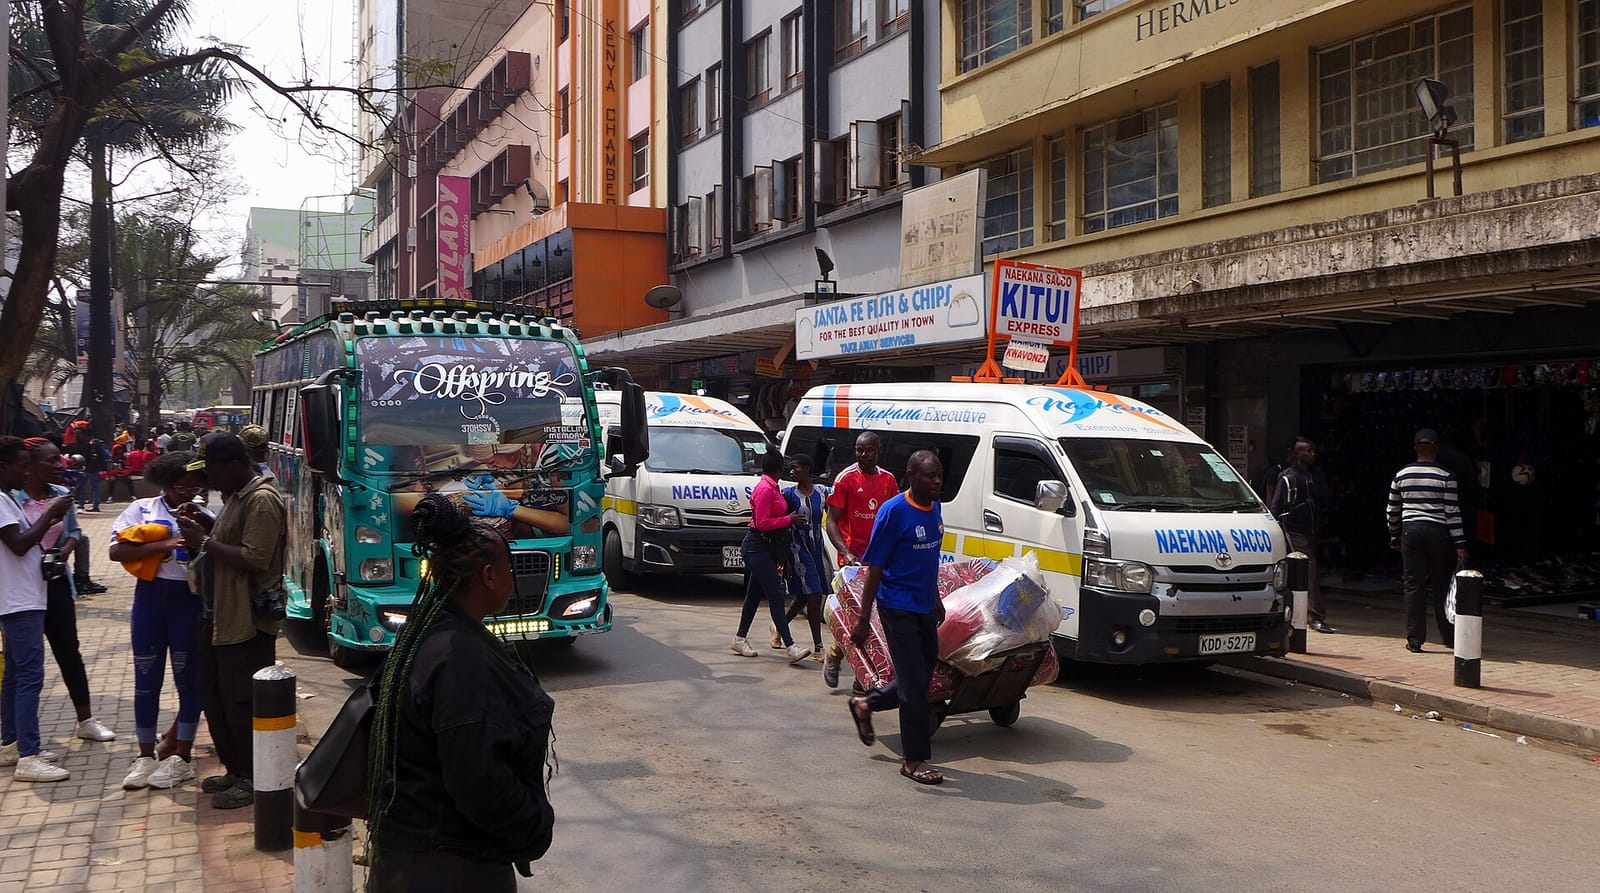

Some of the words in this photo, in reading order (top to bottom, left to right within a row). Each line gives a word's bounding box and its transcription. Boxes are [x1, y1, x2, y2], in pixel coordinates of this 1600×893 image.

[1136, 0, 1239, 42] HERME
[605, 19, 616, 93] KENYA
[1005, 268, 1044, 284] NAEKANA
[1046, 273, 1072, 288] SACCO
[813, 304, 848, 329] SANTA
[851, 301, 864, 322] FE
[867, 295, 895, 319] FISH
[898, 293, 909, 314] &
[912, 284, 953, 311] CHIPS
[1001, 281, 1070, 324] KITUI
[819, 330, 833, 341] FOR
[834, 328, 846, 340] THE
[848, 325, 866, 337] BEST
[867, 320, 899, 335] QUALITY
[901, 319, 910, 329] IN
[911, 315, 935, 327] TOWN
[1007, 320, 1060, 337] EXPRESS
[839, 342, 857, 353] TAKE
[859, 339, 878, 353] AWAY
[879, 333, 916, 350] SERVICES
[1006, 348, 1047, 364] KWAVONZA
[1080, 354, 1113, 376] HIPS
[394, 363, 577, 405] Offspring
[924, 406, 987, 424] Executive
[543, 426, 589, 434] INSTALLING
[549, 432, 585, 440] MEMORY
[1073, 422, 1138, 433] Executive
[672, 485, 738, 500] NAEKANA
[1154, 528, 1229, 553] NAEKANA
[1230, 528, 1273, 553] SACCO
[1201, 636, 1222, 652] KDD
[1227, 635, 1254, 651] 527P
